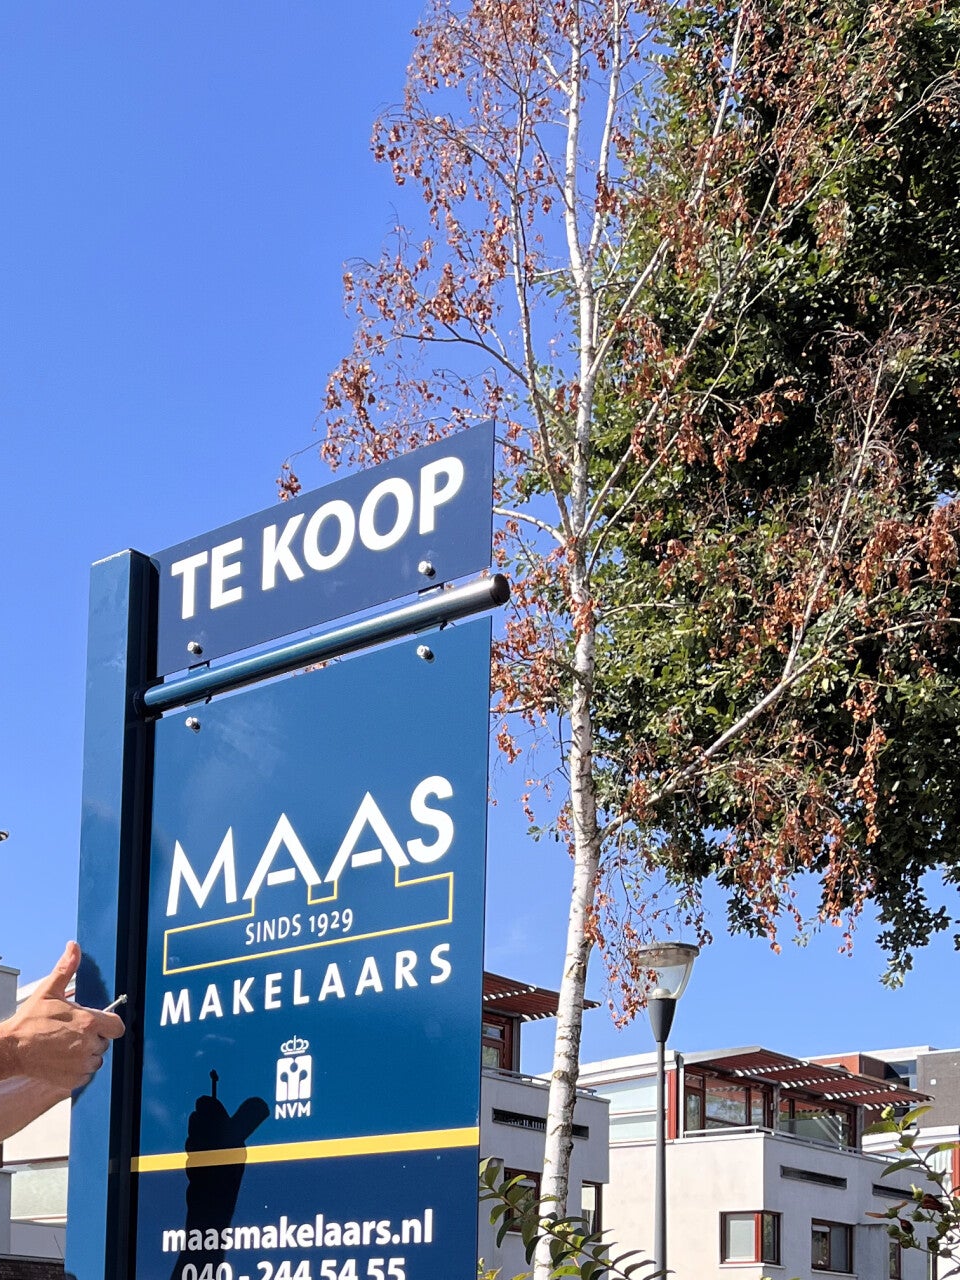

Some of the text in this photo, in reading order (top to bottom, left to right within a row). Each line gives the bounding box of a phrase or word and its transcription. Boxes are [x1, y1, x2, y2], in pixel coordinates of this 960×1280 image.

[171, 456, 465, 620] TE KOOP
[166, 775, 454, 917] MAAS
[244, 908, 354, 946] SINDS 1929
[160, 943, 452, 1027] MAKELAARS
[275, 1101, 311, 1120] NVM
[162, 1208, 433, 1252] maasmakelaars.nl
